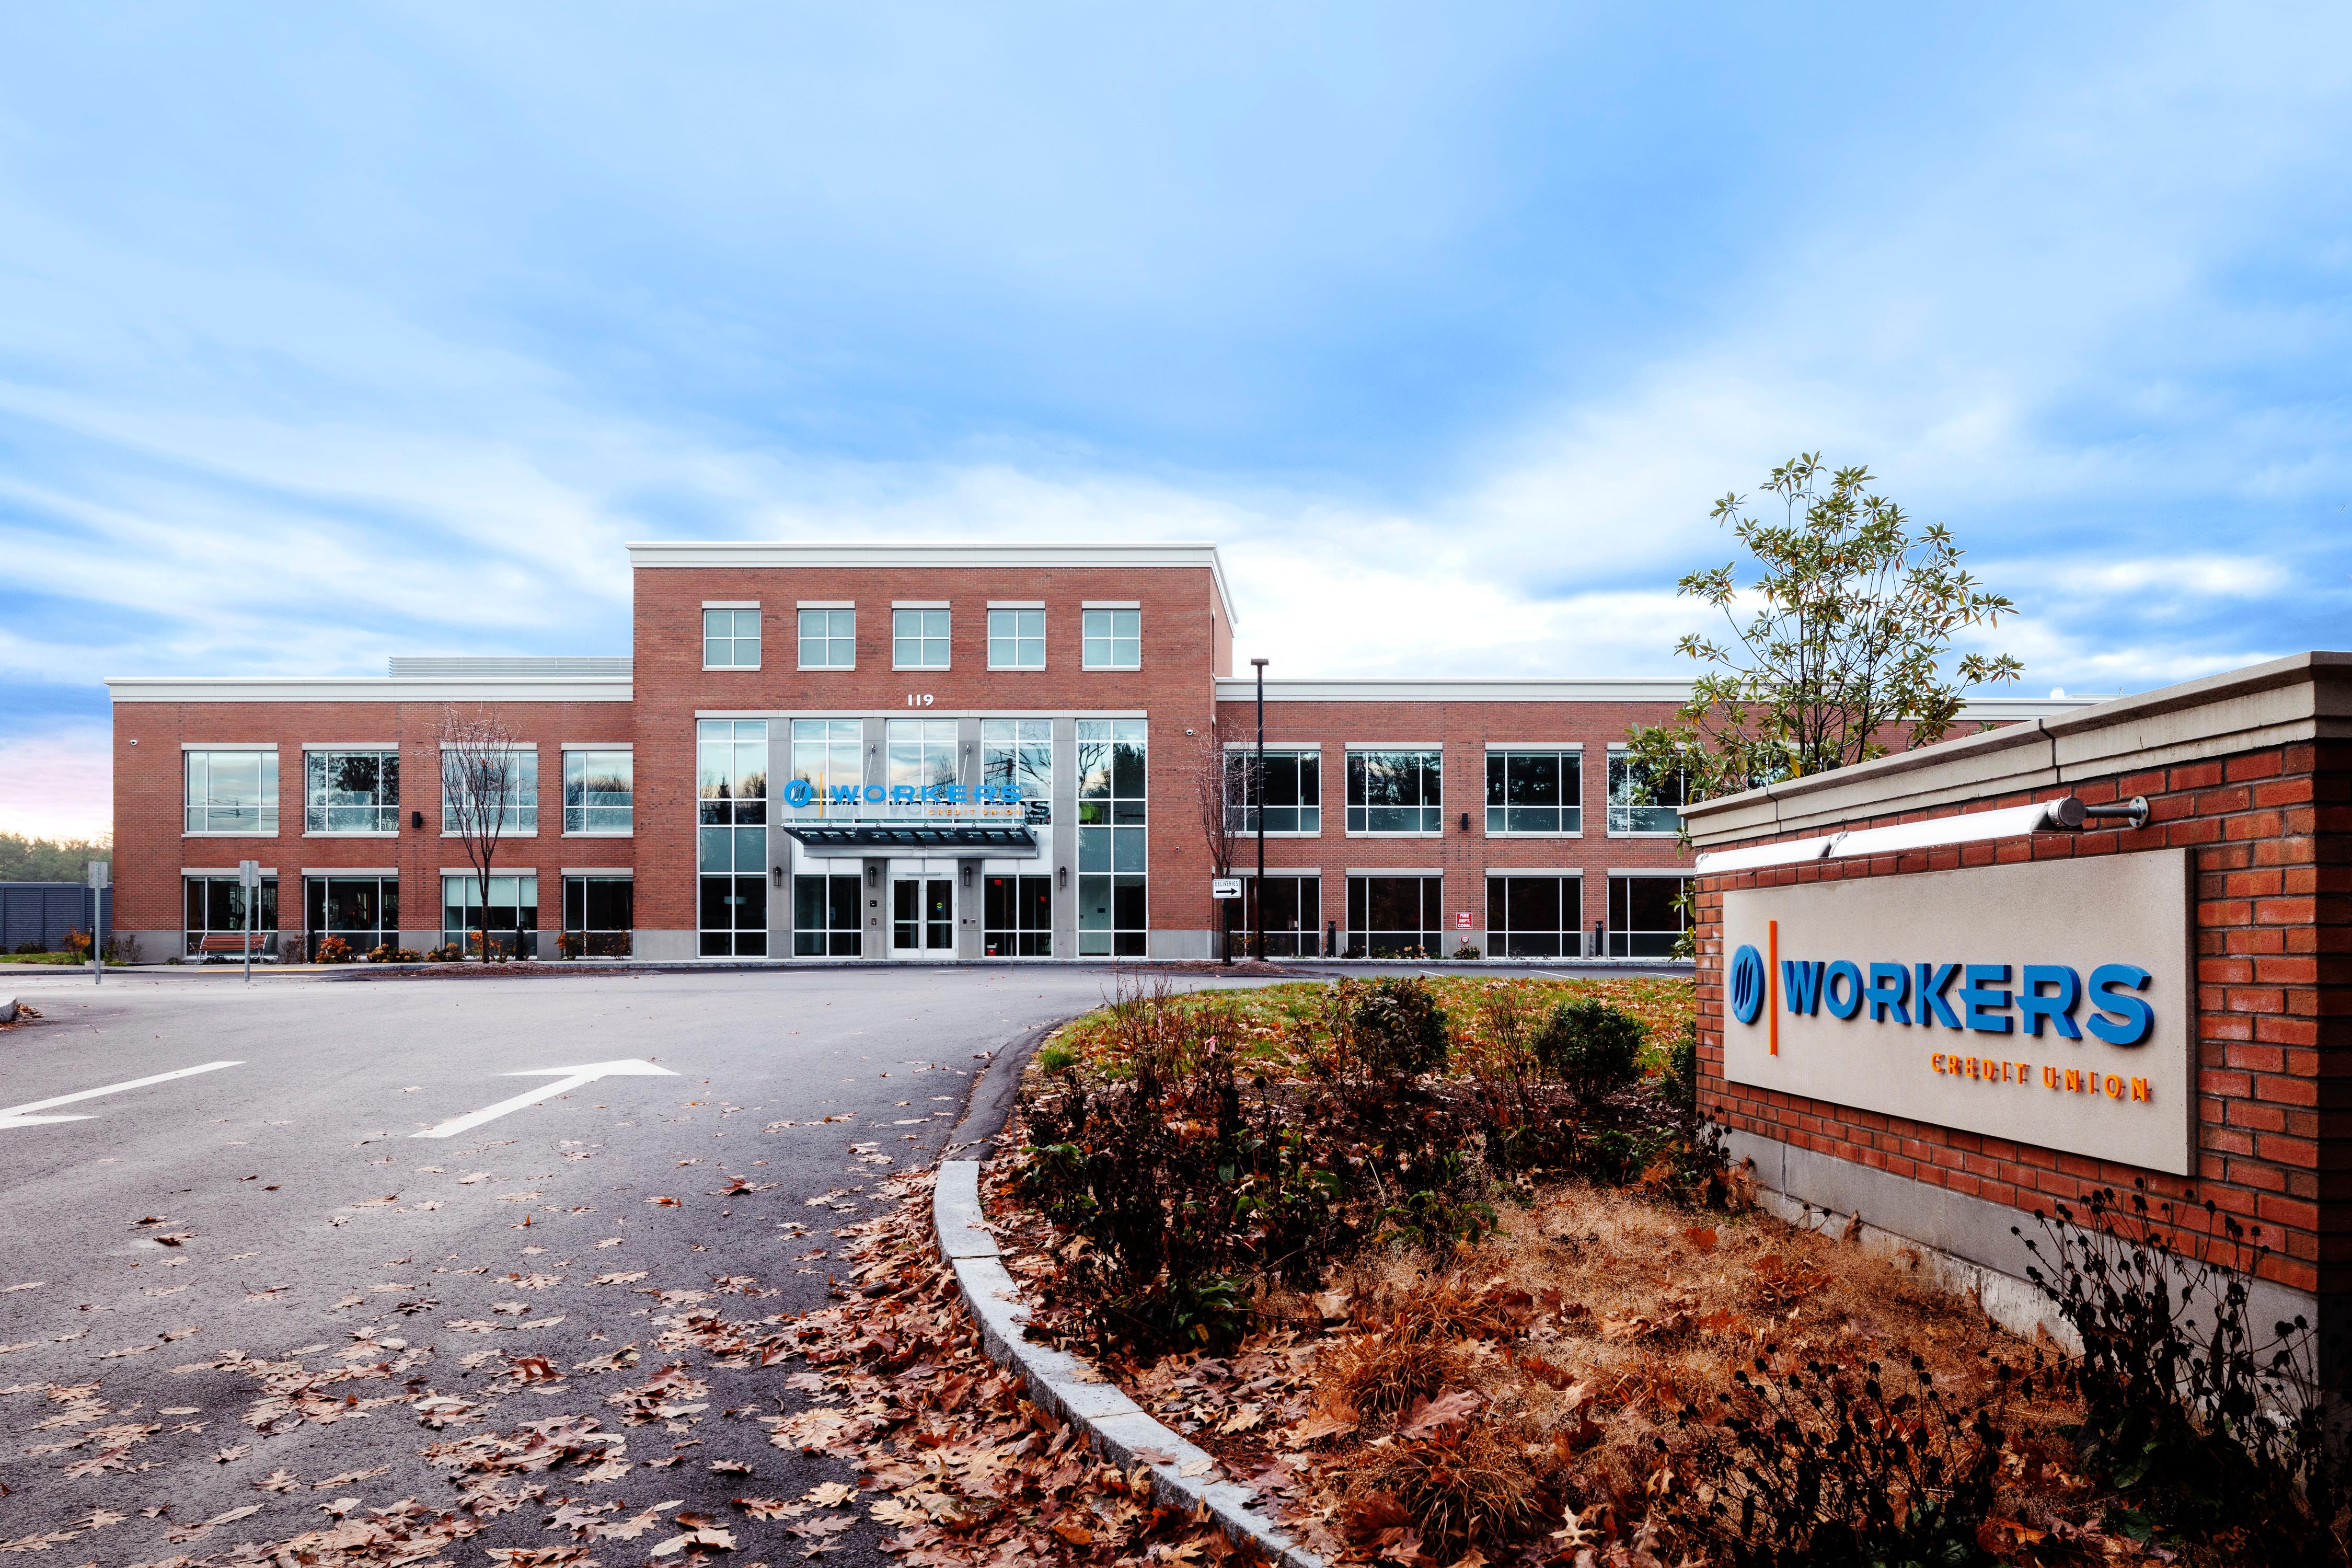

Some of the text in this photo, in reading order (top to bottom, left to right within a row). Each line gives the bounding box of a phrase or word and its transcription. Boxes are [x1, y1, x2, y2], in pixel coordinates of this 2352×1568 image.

[907, 694, 934, 706] 119
[830, 785, 1023, 803] WORKERS
[1781, 960, 2154, 1045] WORKERS
[1931, 1052, 2148, 1102] CREDIT UNION
